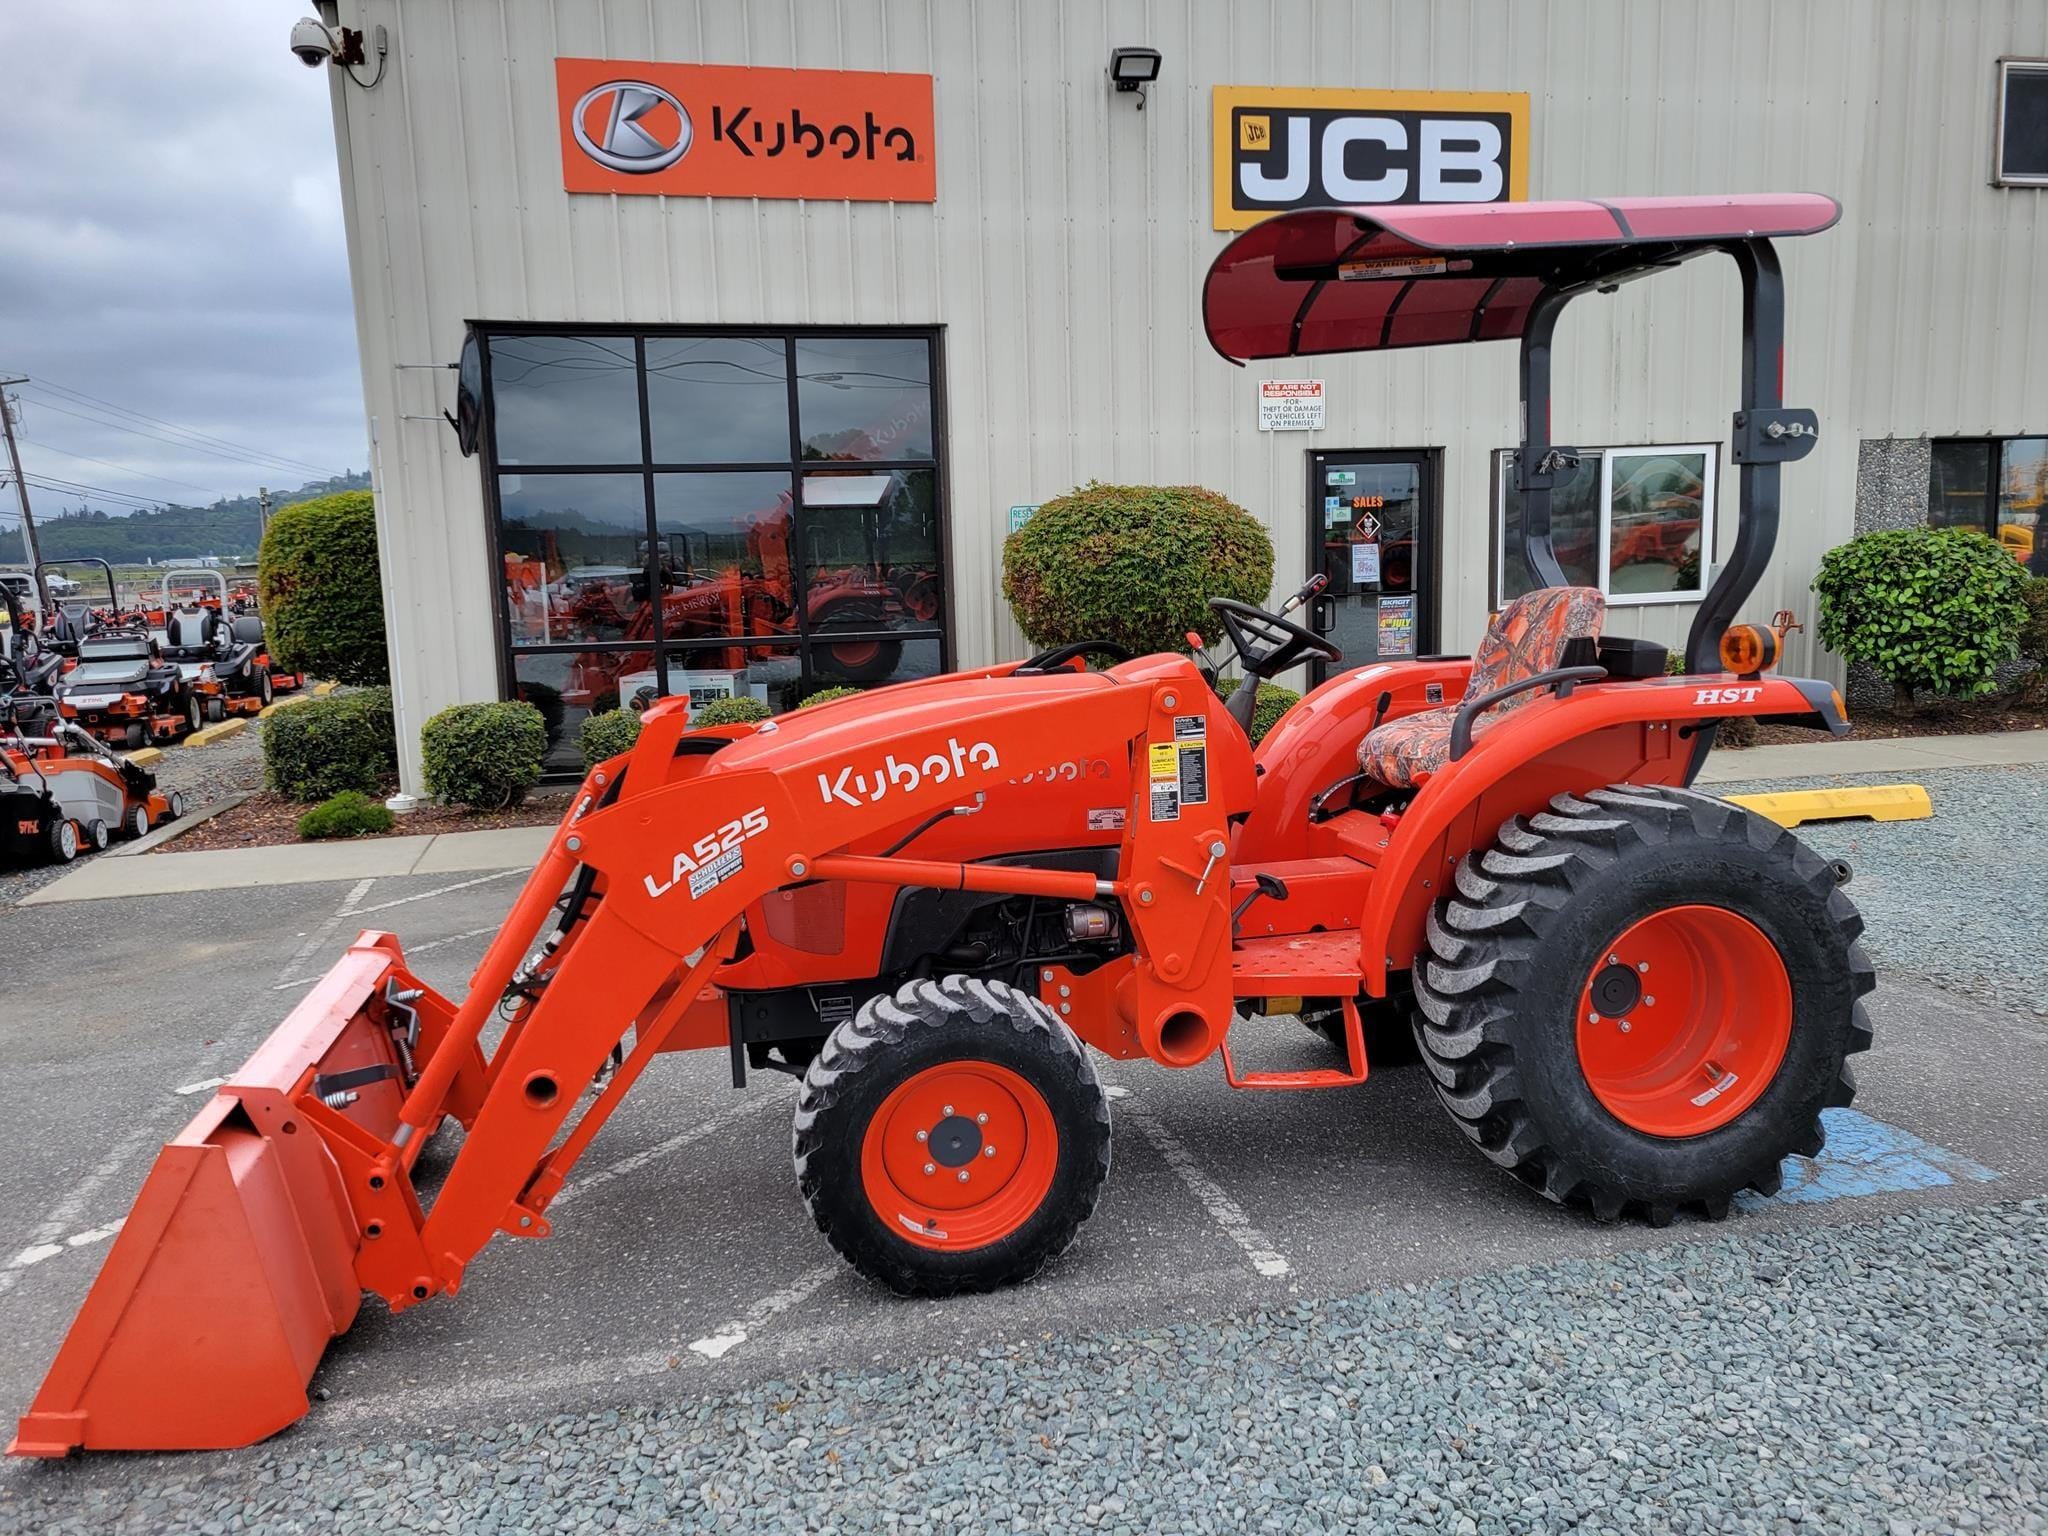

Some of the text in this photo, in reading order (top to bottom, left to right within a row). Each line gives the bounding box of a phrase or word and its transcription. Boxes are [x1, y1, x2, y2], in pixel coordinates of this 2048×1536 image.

[712, 105, 916, 161] Kubota
[1240, 116, 1504, 203] JCB
[1353, 495, 1384, 508] SALES
[1692, 687, 1763, 705] HST
[817, 737, 1000, 807] Kubota
[643, 806, 769, 898] LA525
